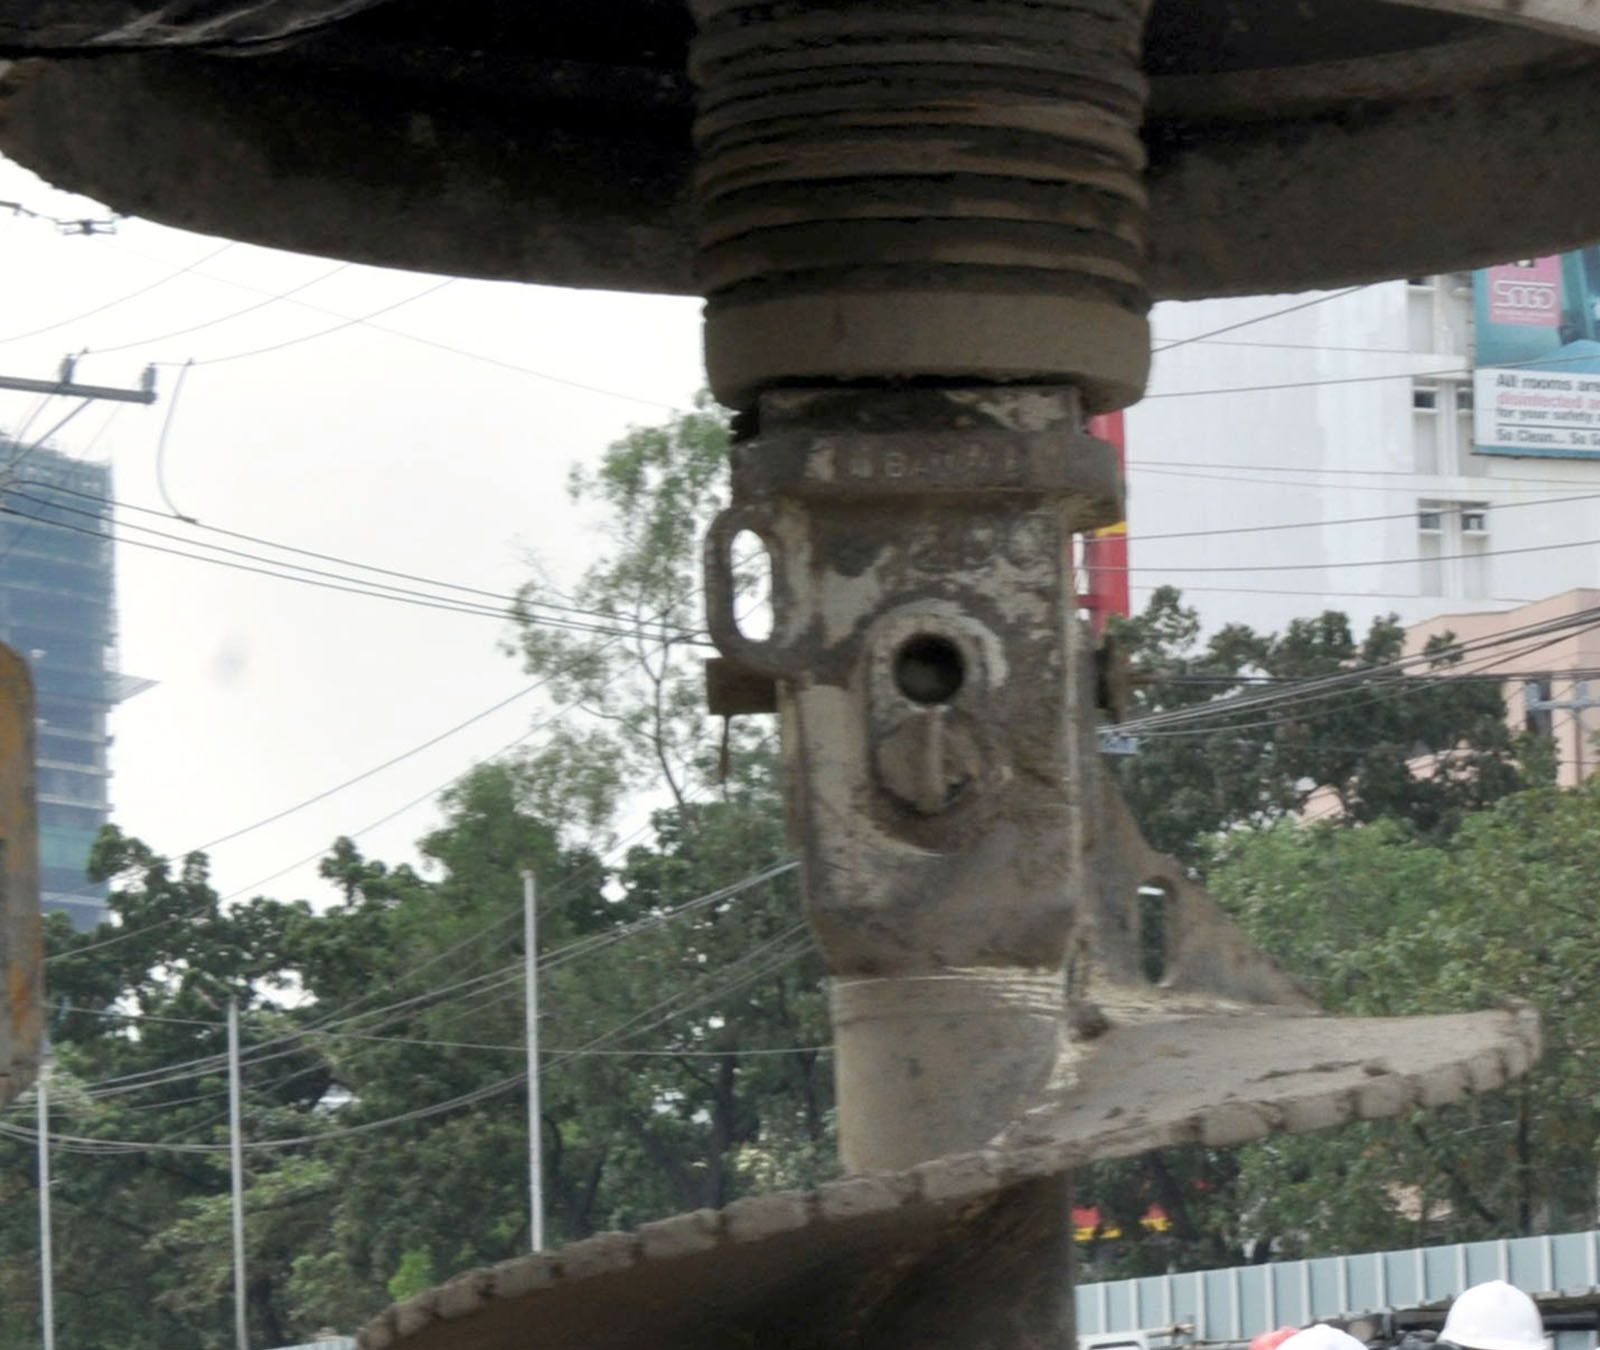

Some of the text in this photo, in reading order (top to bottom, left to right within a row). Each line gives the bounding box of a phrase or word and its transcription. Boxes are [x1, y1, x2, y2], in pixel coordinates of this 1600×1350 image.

[1493, 280, 1556, 310] SOGO
[1497, 374, 1517, 388] All
[1522, 377, 1572, 391] rooms
[1519, 410, 1547, 422] your
[1552, 411, 1592, 424] safety
[1497, 429, 1511, 441] So
[1571, 432, 1585, 444] So
